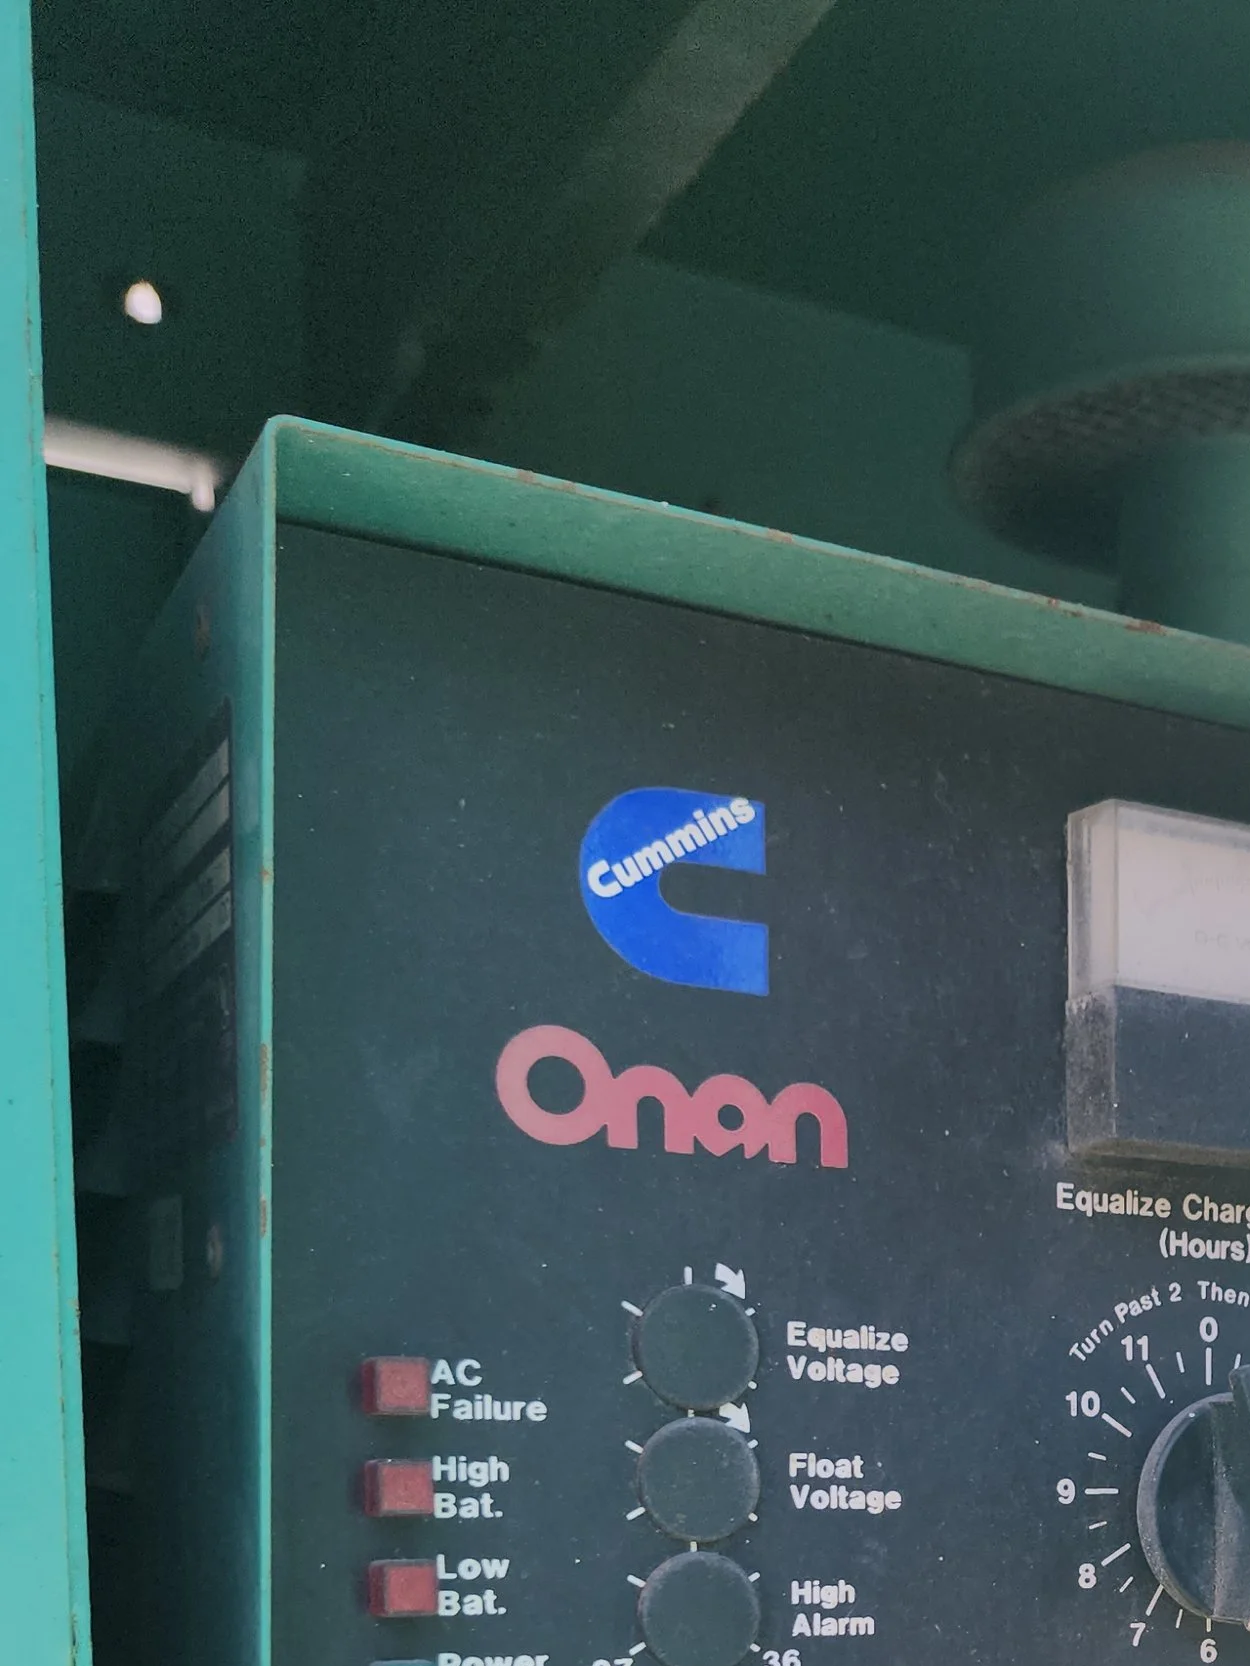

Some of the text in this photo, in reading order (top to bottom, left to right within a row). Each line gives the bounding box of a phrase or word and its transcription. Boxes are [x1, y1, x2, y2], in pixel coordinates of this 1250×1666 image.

[587, 797, 756, 898] Cummins
[495, 1024, 848, 1168] Onan
[1056, 1182, 1172, 1218] Equalize
[1069, 1319, 1114, 1361] Turn
[1114, 1287, 1161, 1324] Past
[1168, 1282, 1182, 1302] 2
[1197, 1280, 1250, 1307] Then
[1200, 1316, 1219, 1342] 0
[787, 1321, 909, 1354] Equalize
[1121, 1335, 1148, 1361] 11
[430, 1359, 482, 1387] AC
[787, 1355, 900, 1389] Voltage
[430, 1394, 548, 1422] Failure
[1065, 1390, 1100, 1417] 10
[433, 1456, 509, 1486] High
[789, 1453, 864, 1479] Float
[790, 1484, 902, 1515] Voltage
[1056, 1478, 1076, 1505] 9
[433, 1492, 504, 1520] Bat.
[436, 1554, 509, 1580] Low
[1078, 1563, 1096, 1589] 8
[437, 1590, 507, 1617] Bat.
[791, 1580, 855, 1609] High
[792, 1614, 875, 1637] Alarm
[1130, 1622, 1146, 1647] 7
[1200, 1638, 1218, 1664] 6
